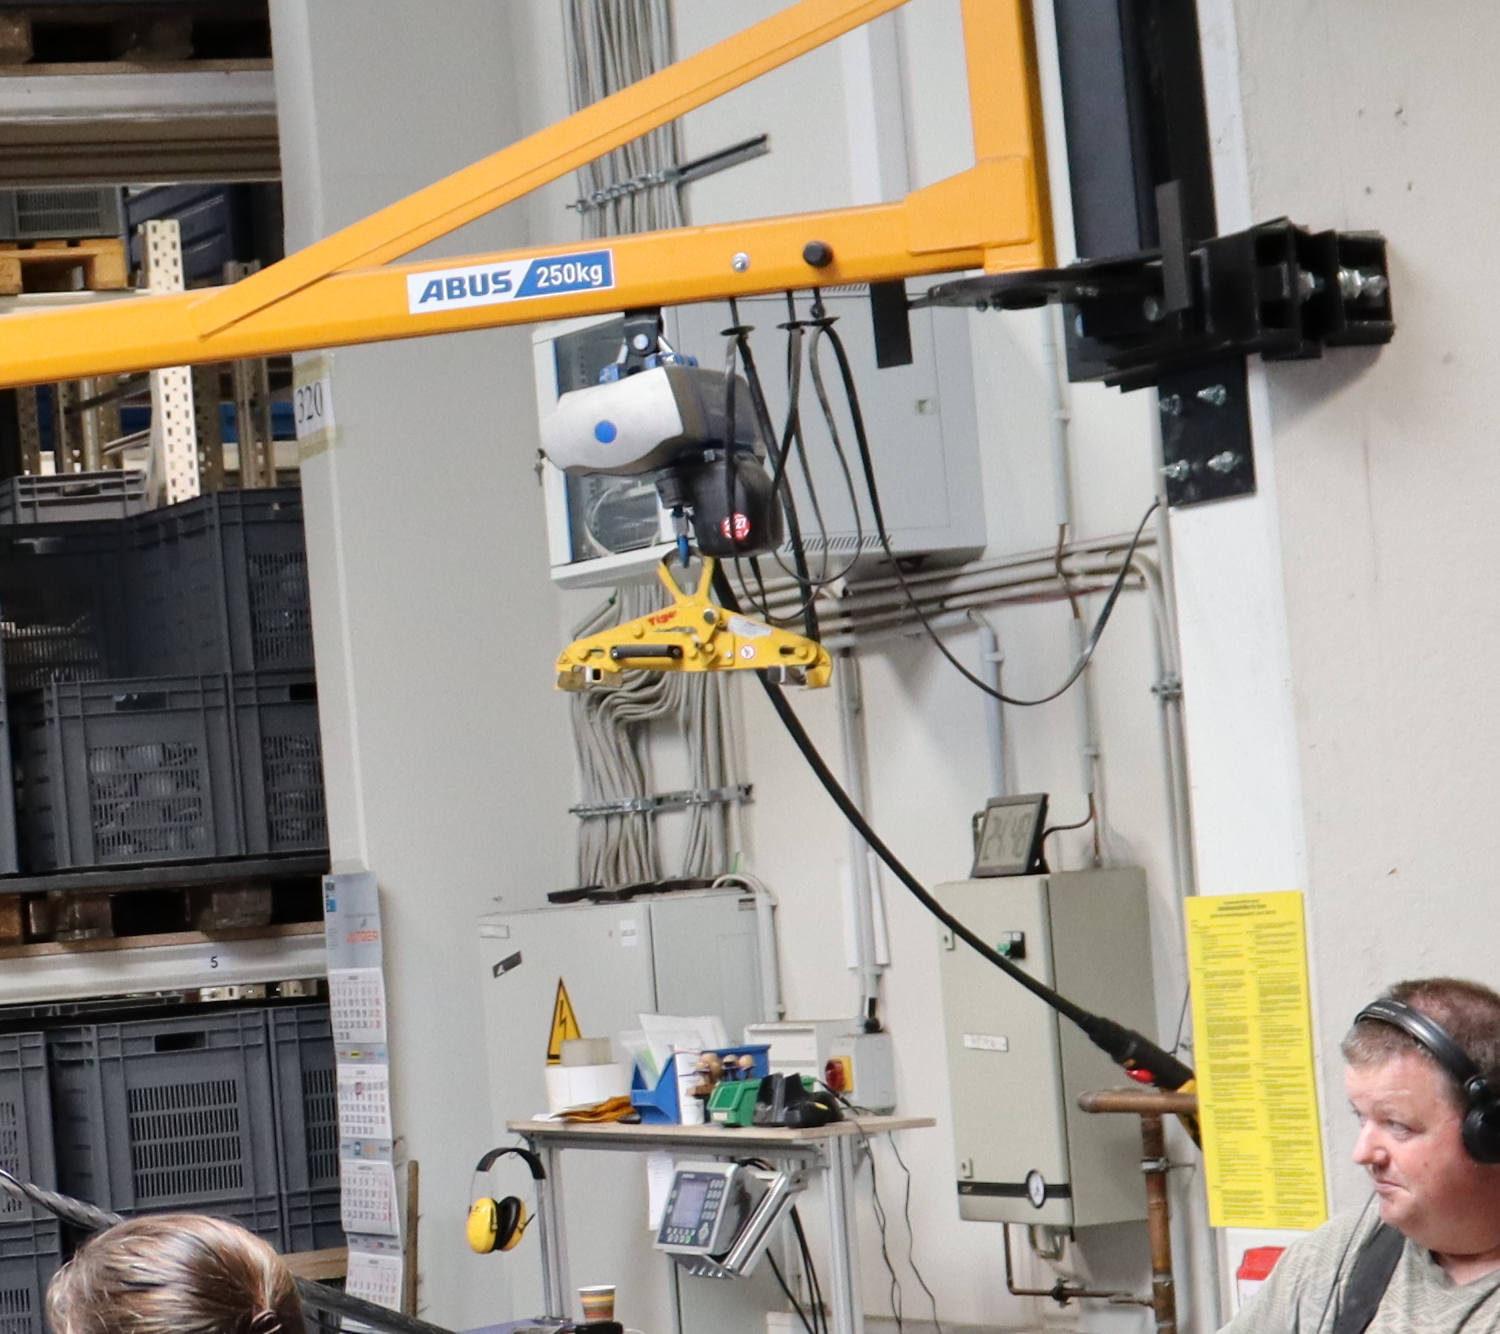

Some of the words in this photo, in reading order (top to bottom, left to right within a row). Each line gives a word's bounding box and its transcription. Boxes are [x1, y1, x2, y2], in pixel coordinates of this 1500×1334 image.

[418, 270, 513, 304] ABUS
[536, 262, 603, 288] 250kg
[297, 381, 323, 424] 320
[210, 955, 219, 969] 5
